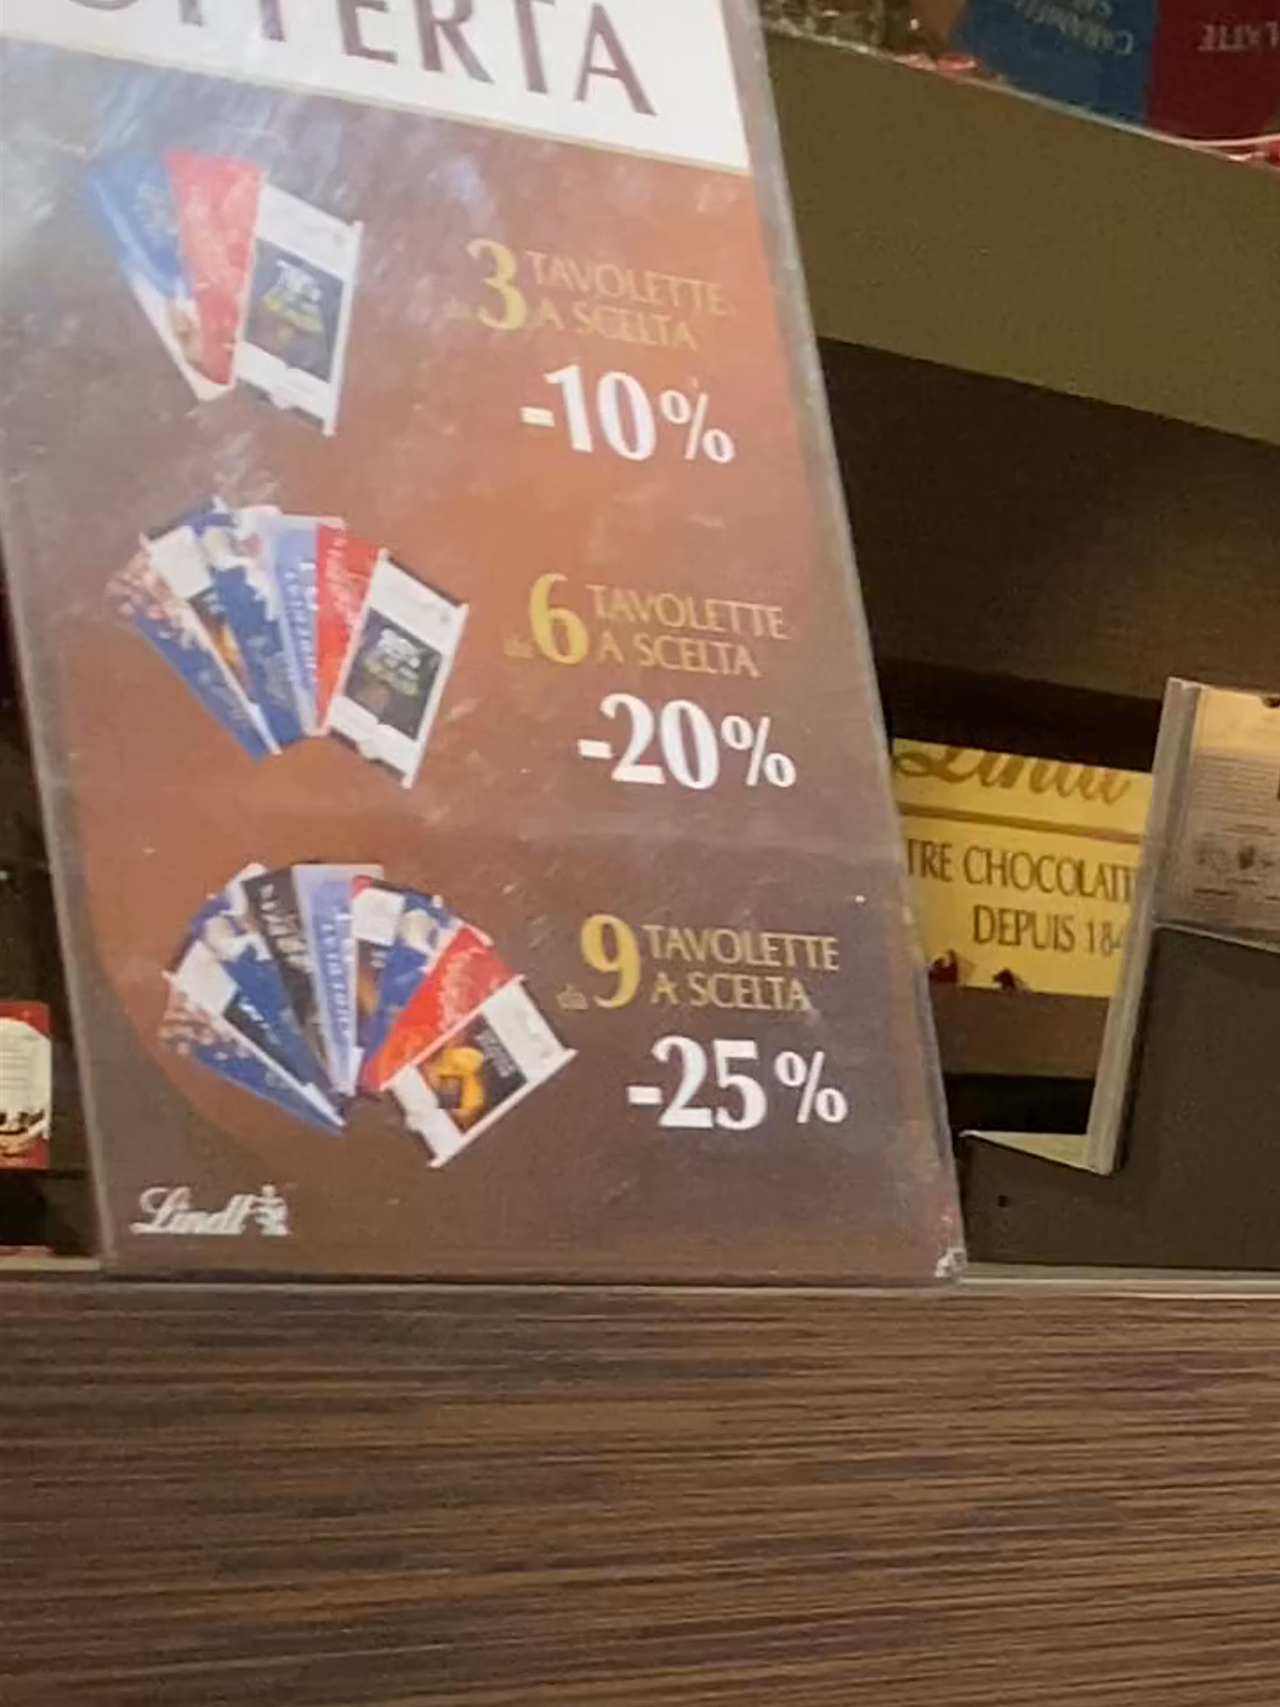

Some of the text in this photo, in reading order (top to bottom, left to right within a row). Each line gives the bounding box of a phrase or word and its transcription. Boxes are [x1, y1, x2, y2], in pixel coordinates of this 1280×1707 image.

[469, 239, 728, 331] 3 TAVOLETTE
[539, 303, 697, 350] A SCELTA
[522, 364, 734, 462] -10%
[529, 572, 789, 664] 6 TAVOLETTE
[598, 633, 759, 677] A SCELTA
[580, 693, 795, 789] -20%
[580, 913, 641, 1008] 9
[642, 923, 839, 970] TAVOLETTE
[973, 905, 1075, 952] DEPUIS
[651, 974, 809, 1011] A SCELTA
[627, 1035, 848, 1128] -25%
